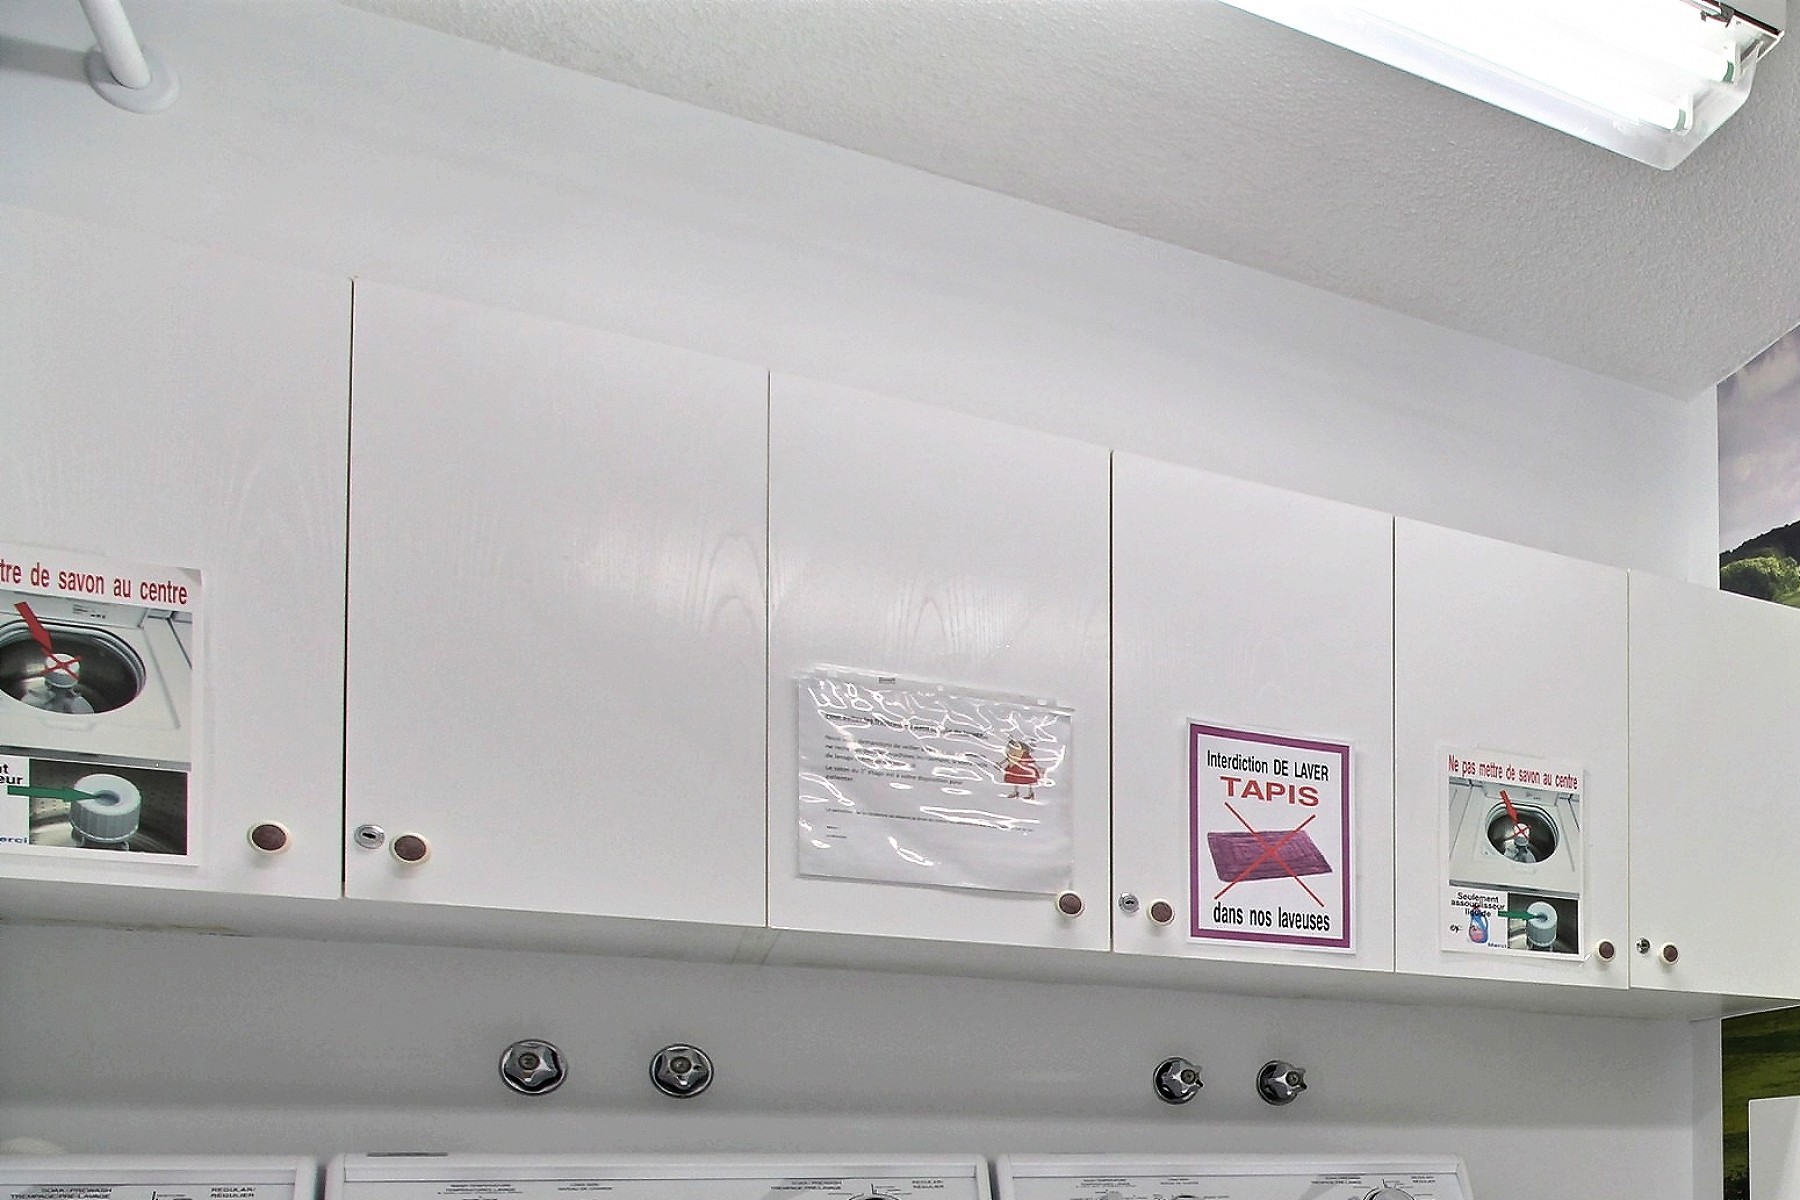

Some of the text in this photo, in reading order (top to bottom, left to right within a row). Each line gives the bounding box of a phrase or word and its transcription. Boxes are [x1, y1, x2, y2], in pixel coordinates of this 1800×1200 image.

[31, 562, 50, 587] de
[58, 571, 104, 595] savon
[113, 578, 130, 598] au
[140, 581, 187, 604] centre
[1207, 750, 1329, 781] Interdiction DE LAVER
[1448, 754, 1578, 790] Ne pas mettre de savon au centre
[1220, 776, 1319, 807] TAPIS
[1457, 892, 1499, 903] Seulement
[1213, 901, 1330, 932] dans nos laveuses
